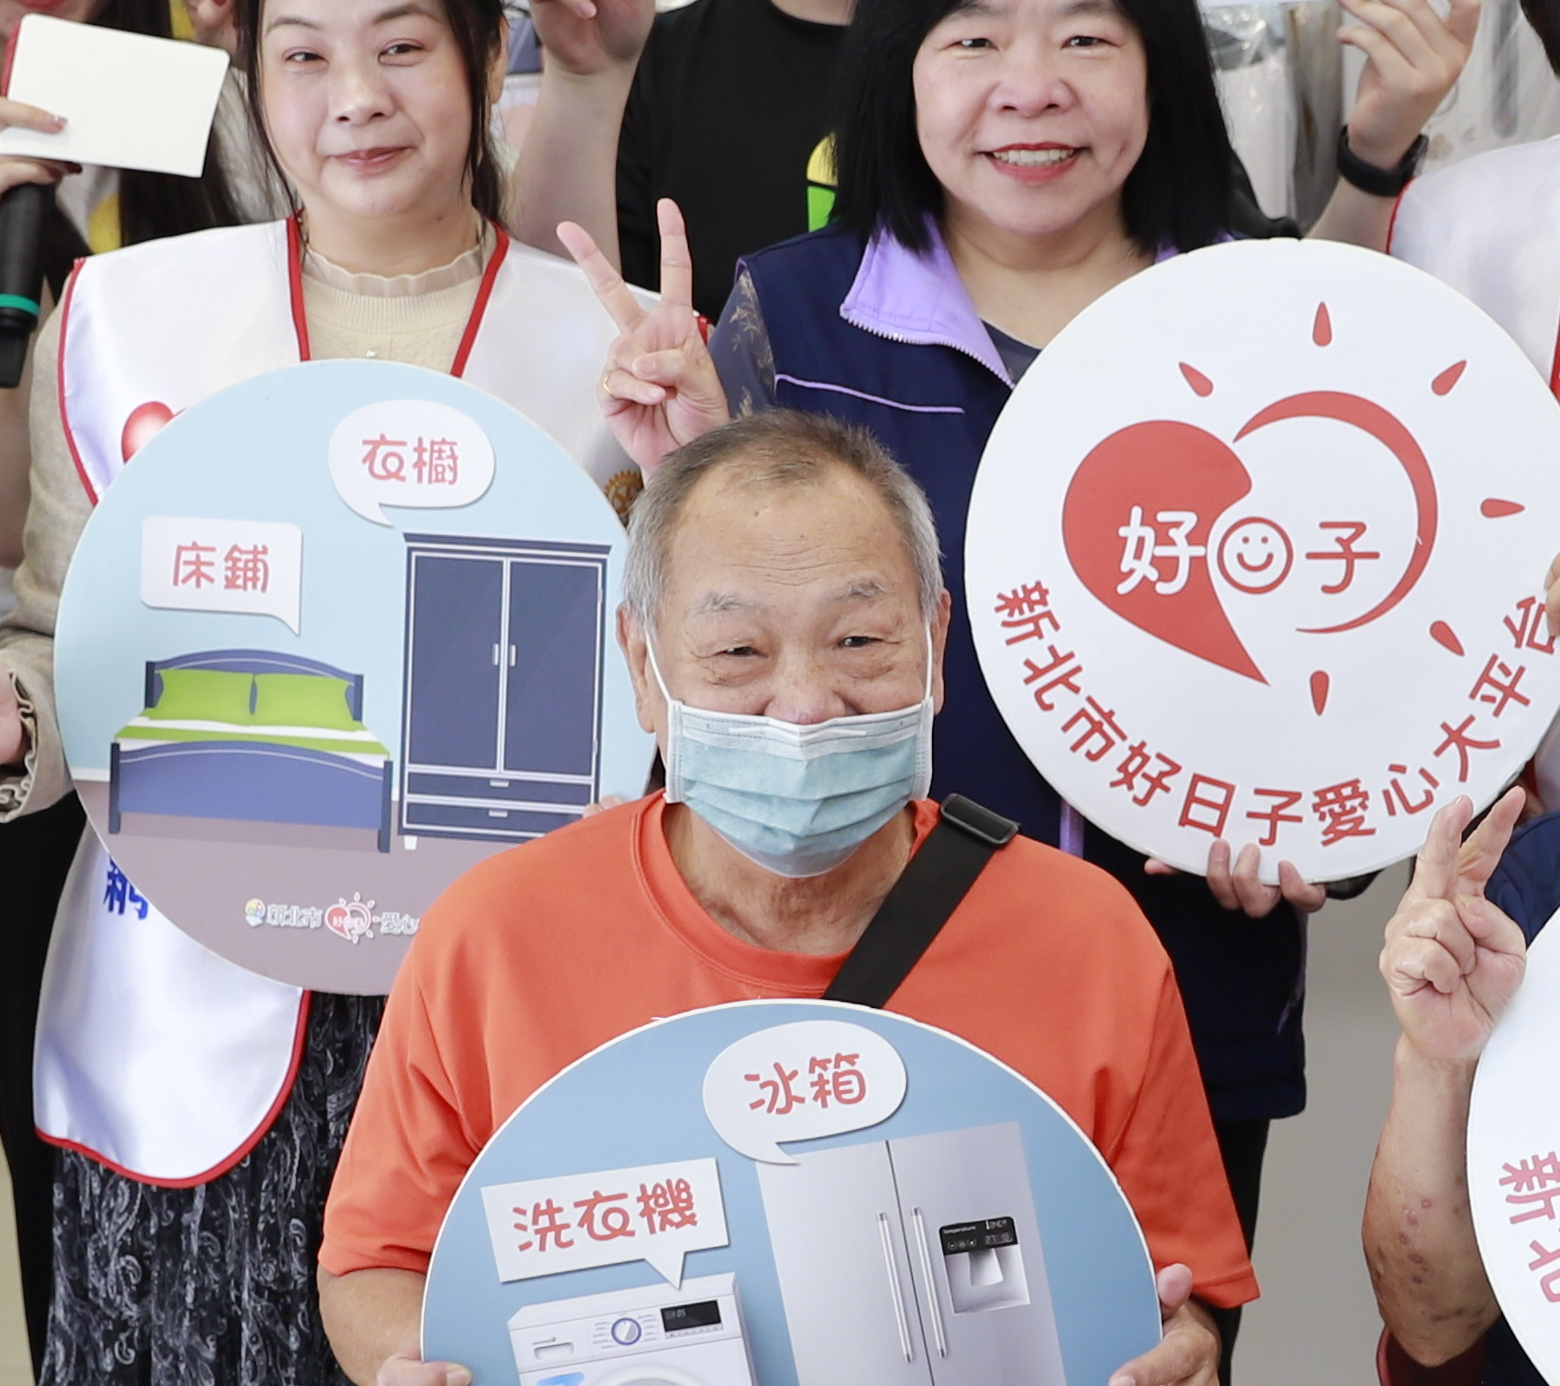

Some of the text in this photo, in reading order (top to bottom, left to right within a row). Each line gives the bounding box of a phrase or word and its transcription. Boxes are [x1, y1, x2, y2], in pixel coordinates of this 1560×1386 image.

[361, 434, 460, 487] 衣櫥
[172, 541, 270, 593] 床鋪
[994, 581, 1558, 847] 新北市好日子愛心大平台
[743, 1052, 868, 1116] 冰箱
[510, 1178, 698, 1253] 洗衣機
